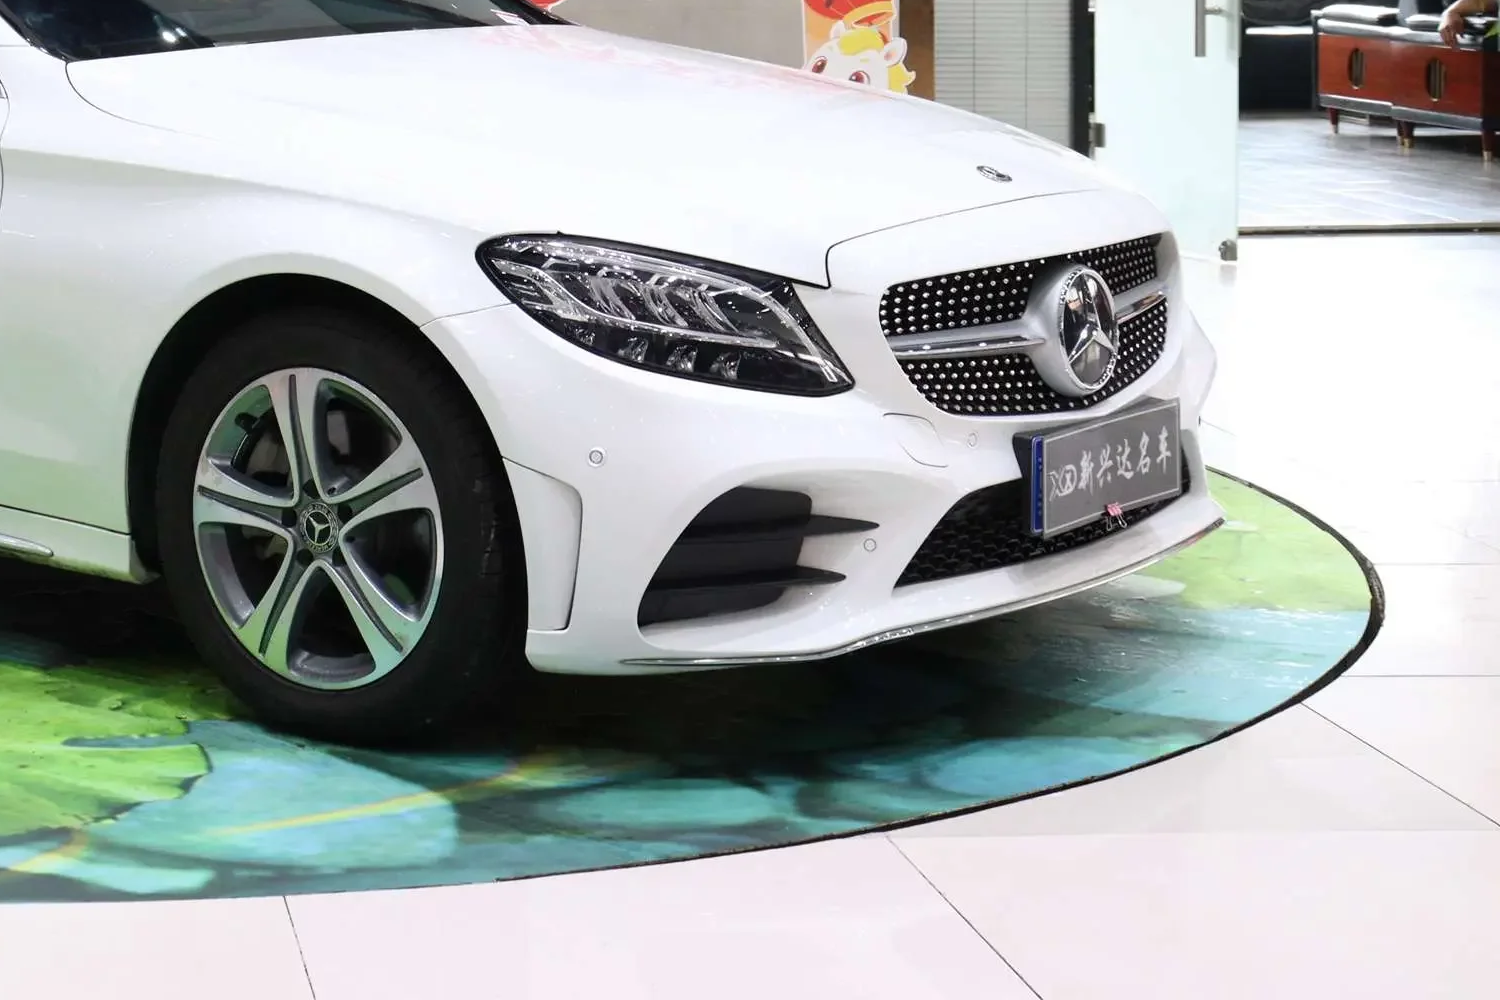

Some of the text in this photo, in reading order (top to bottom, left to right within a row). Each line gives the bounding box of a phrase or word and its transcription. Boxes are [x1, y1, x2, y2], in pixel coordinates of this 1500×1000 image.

[1078, 425, 1172, 496] 新兴达名车
